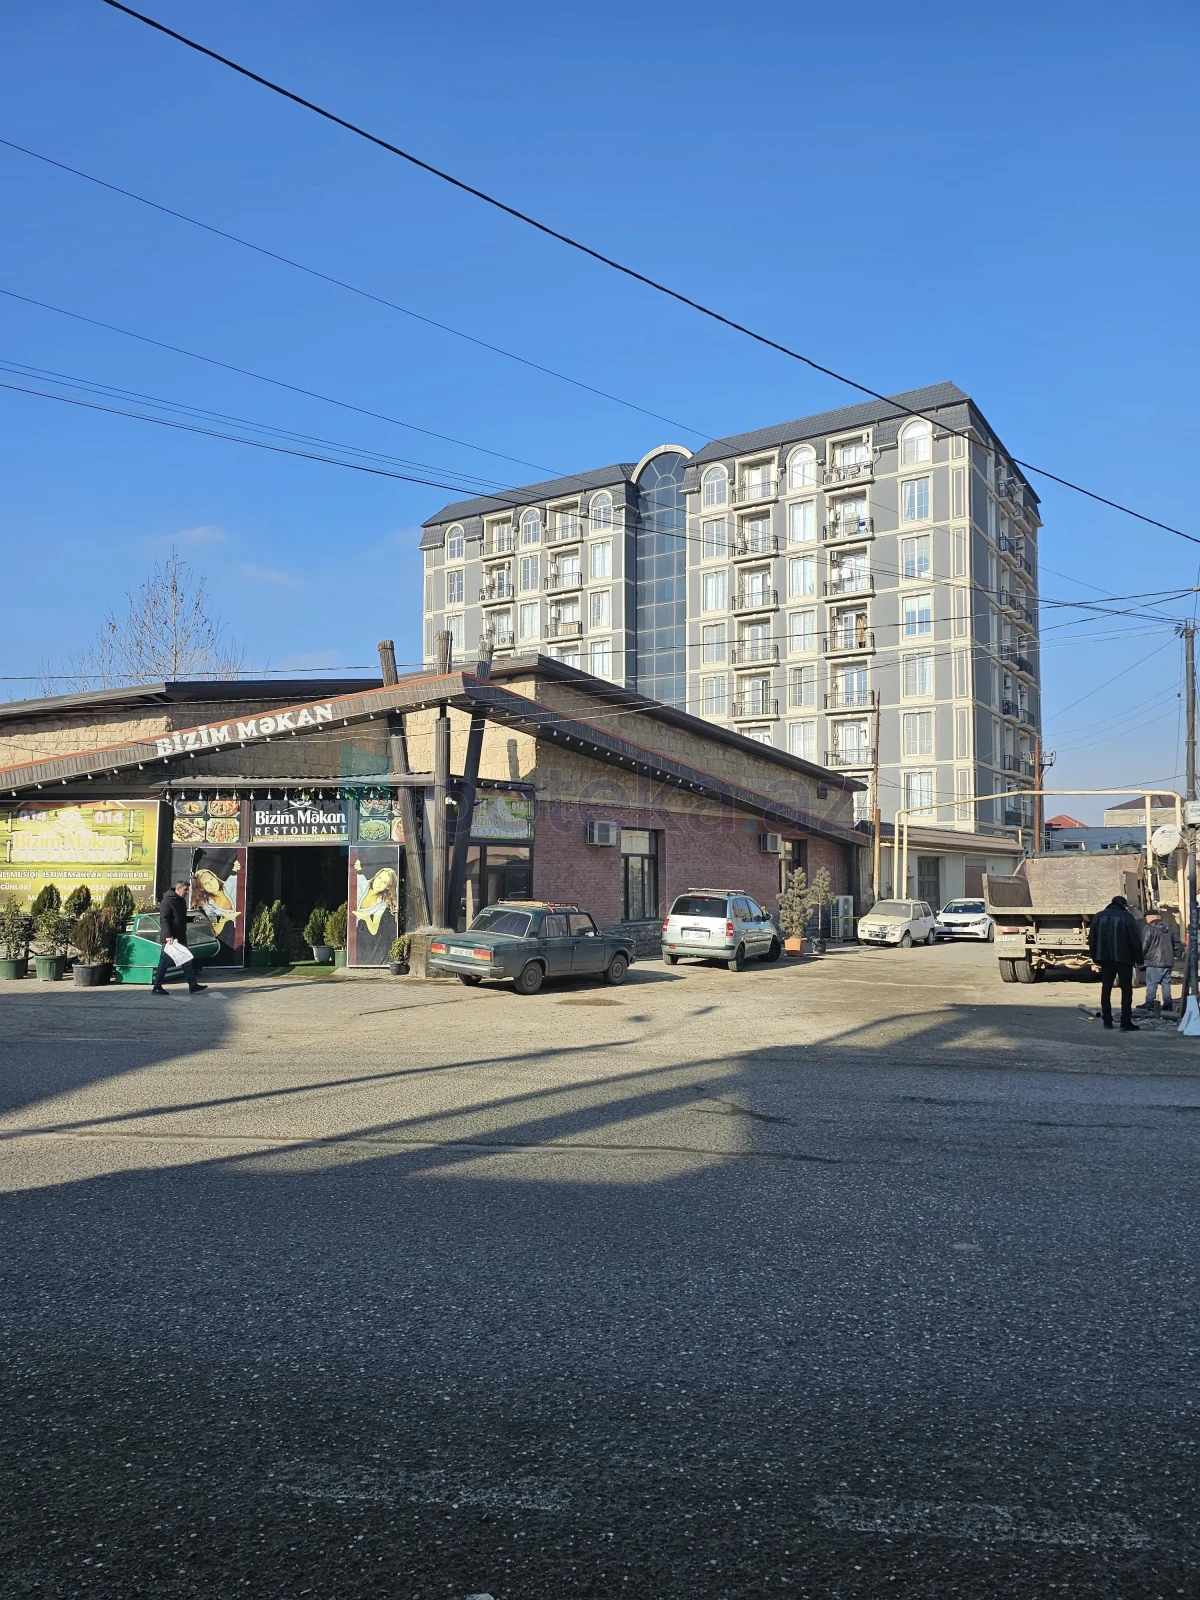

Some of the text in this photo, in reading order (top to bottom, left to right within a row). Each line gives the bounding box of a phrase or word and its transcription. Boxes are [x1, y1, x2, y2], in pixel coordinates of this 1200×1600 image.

[155, 703, 333, 756] BİZİM MƏKAN
[94, 811, 123, 825] 014
[255, 809, 347, 825] Bizim Məkan
[254, 826, 347, 836] RESTOURANT
[14, 832, 61, 849] Bizim
